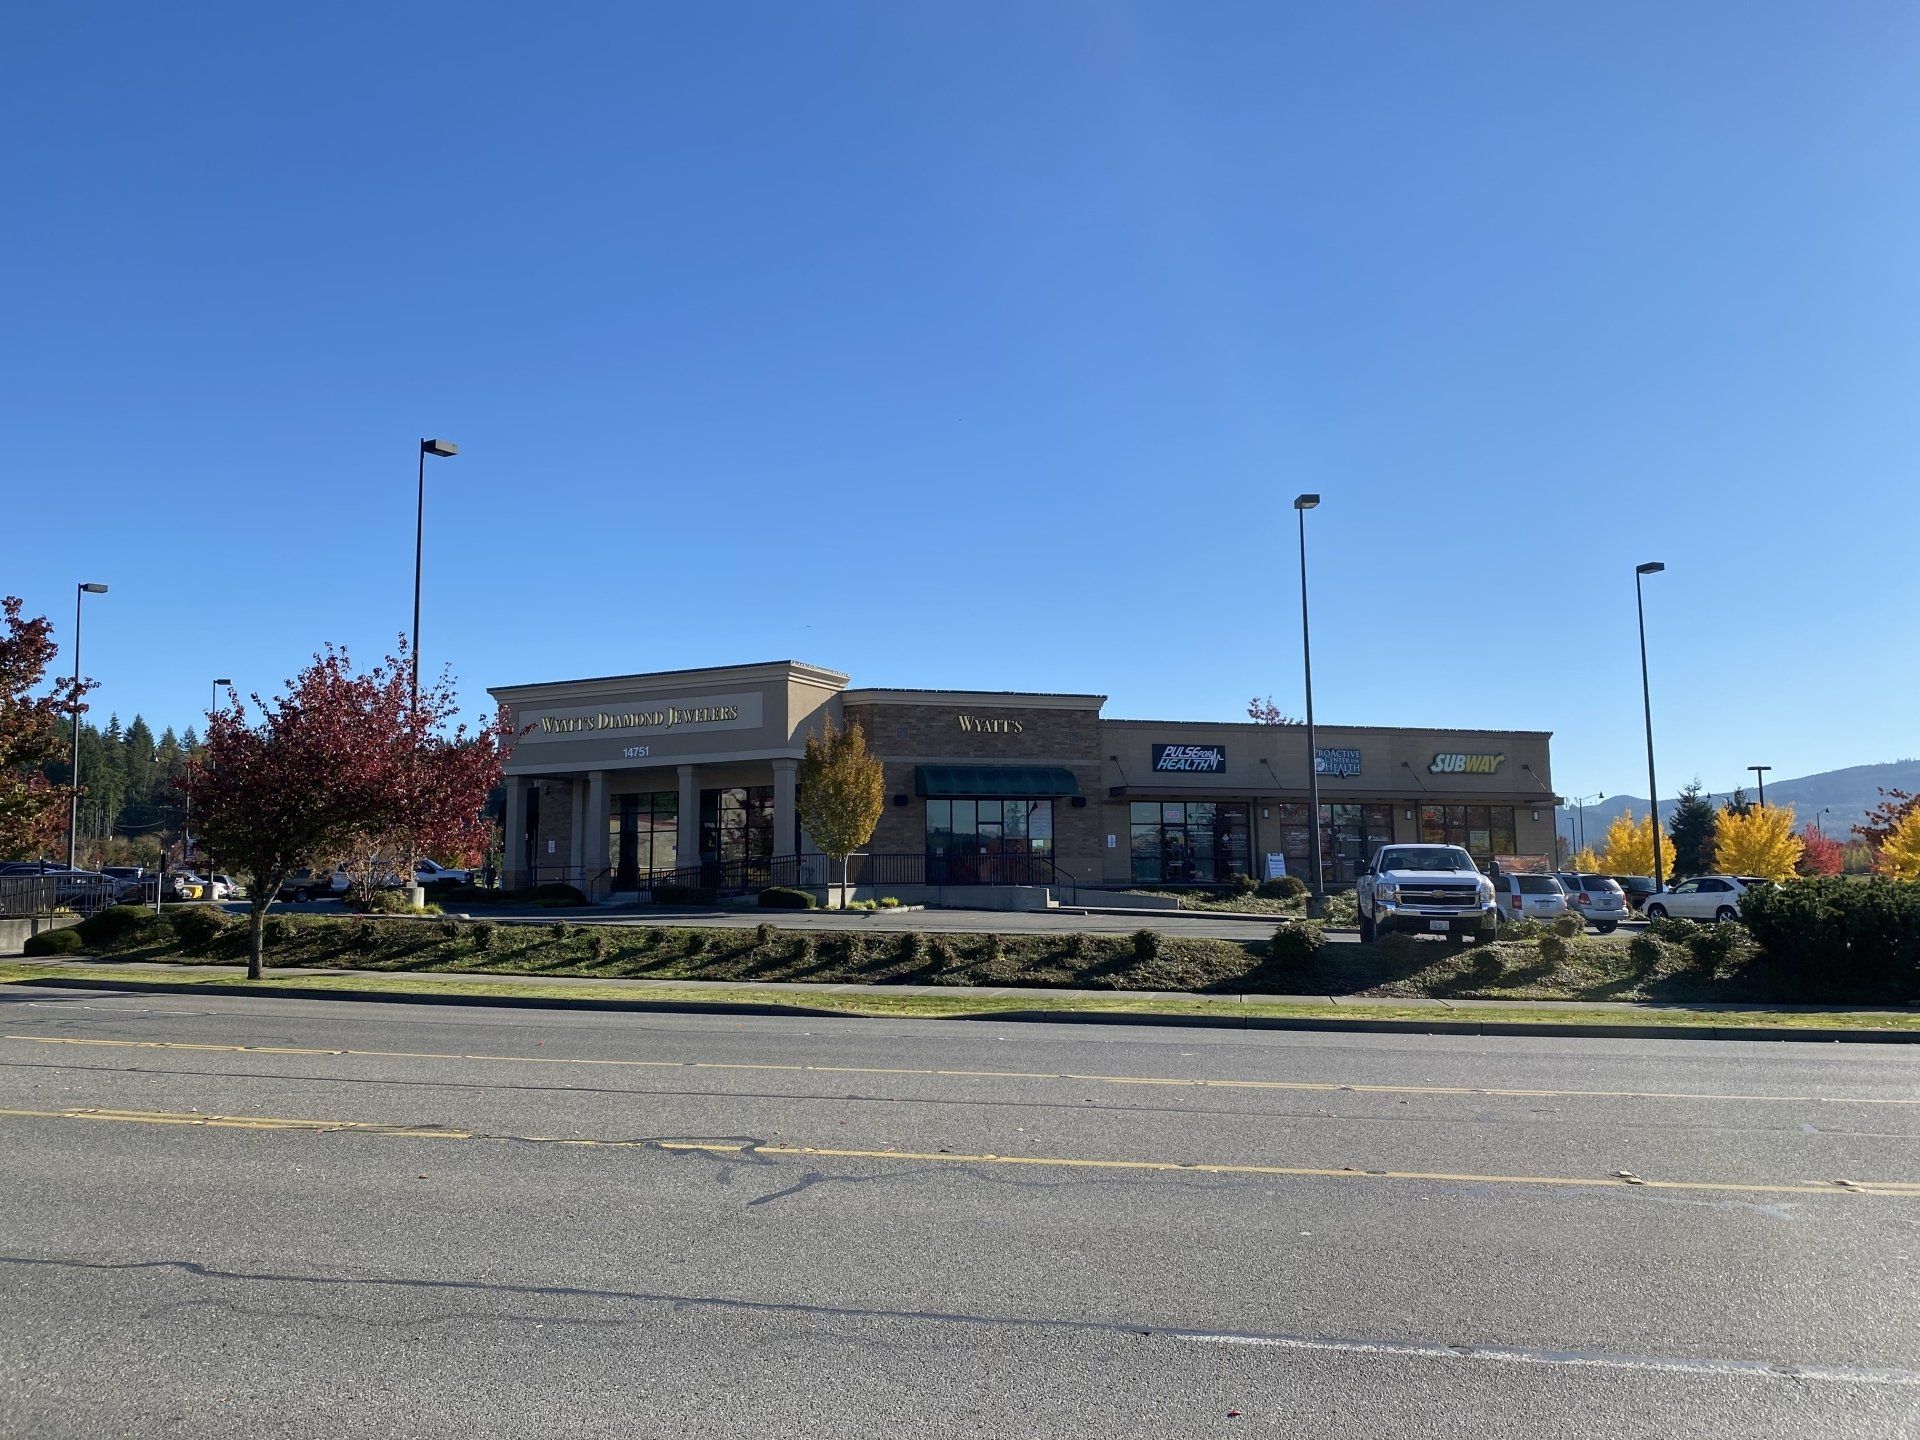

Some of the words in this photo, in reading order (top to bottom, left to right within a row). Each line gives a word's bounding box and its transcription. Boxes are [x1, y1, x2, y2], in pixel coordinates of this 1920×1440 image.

[541, 715, 595, 733] WYATT'S
[597, 710, 665, 730] DIAMOND
[665, 705, 738, 729] JEWELERS
[957, 715, 1023, 734] WYATT'S
[623, 746, 650, 758] 14751
[1156, 758, 1211, 771] HEALTH
[1325, 763, 1361, 772] HEALTH
[1430, 753, 1505, 773] SUBWAY
